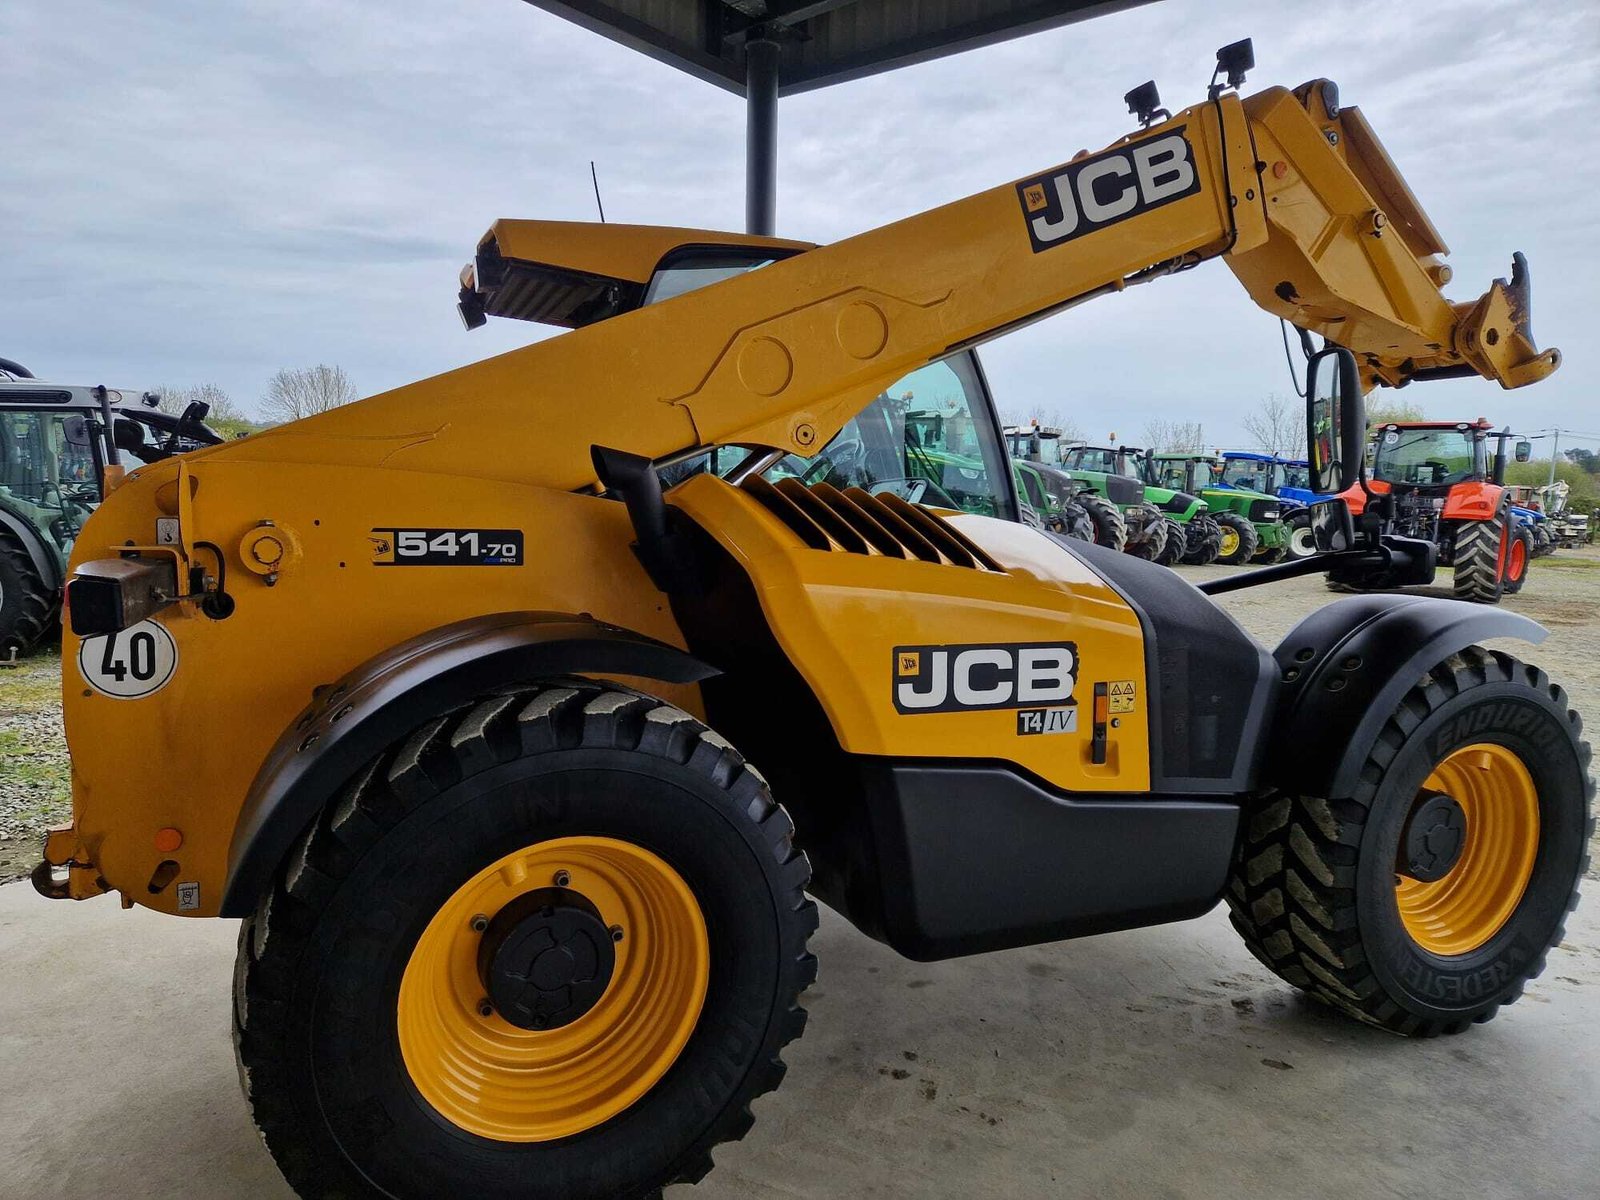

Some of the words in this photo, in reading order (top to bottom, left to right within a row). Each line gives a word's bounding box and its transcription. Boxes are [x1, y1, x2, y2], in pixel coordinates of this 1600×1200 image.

[1032, 135, 1194, 242] JCB
[397, 531, 516, 557] 541-70
[101, 631, 156, 682] 40
[898, 648, 1075, 708] JCB
[1020, 712, 1043, 733] T4
[1048, 711, 1074, 731] IV
